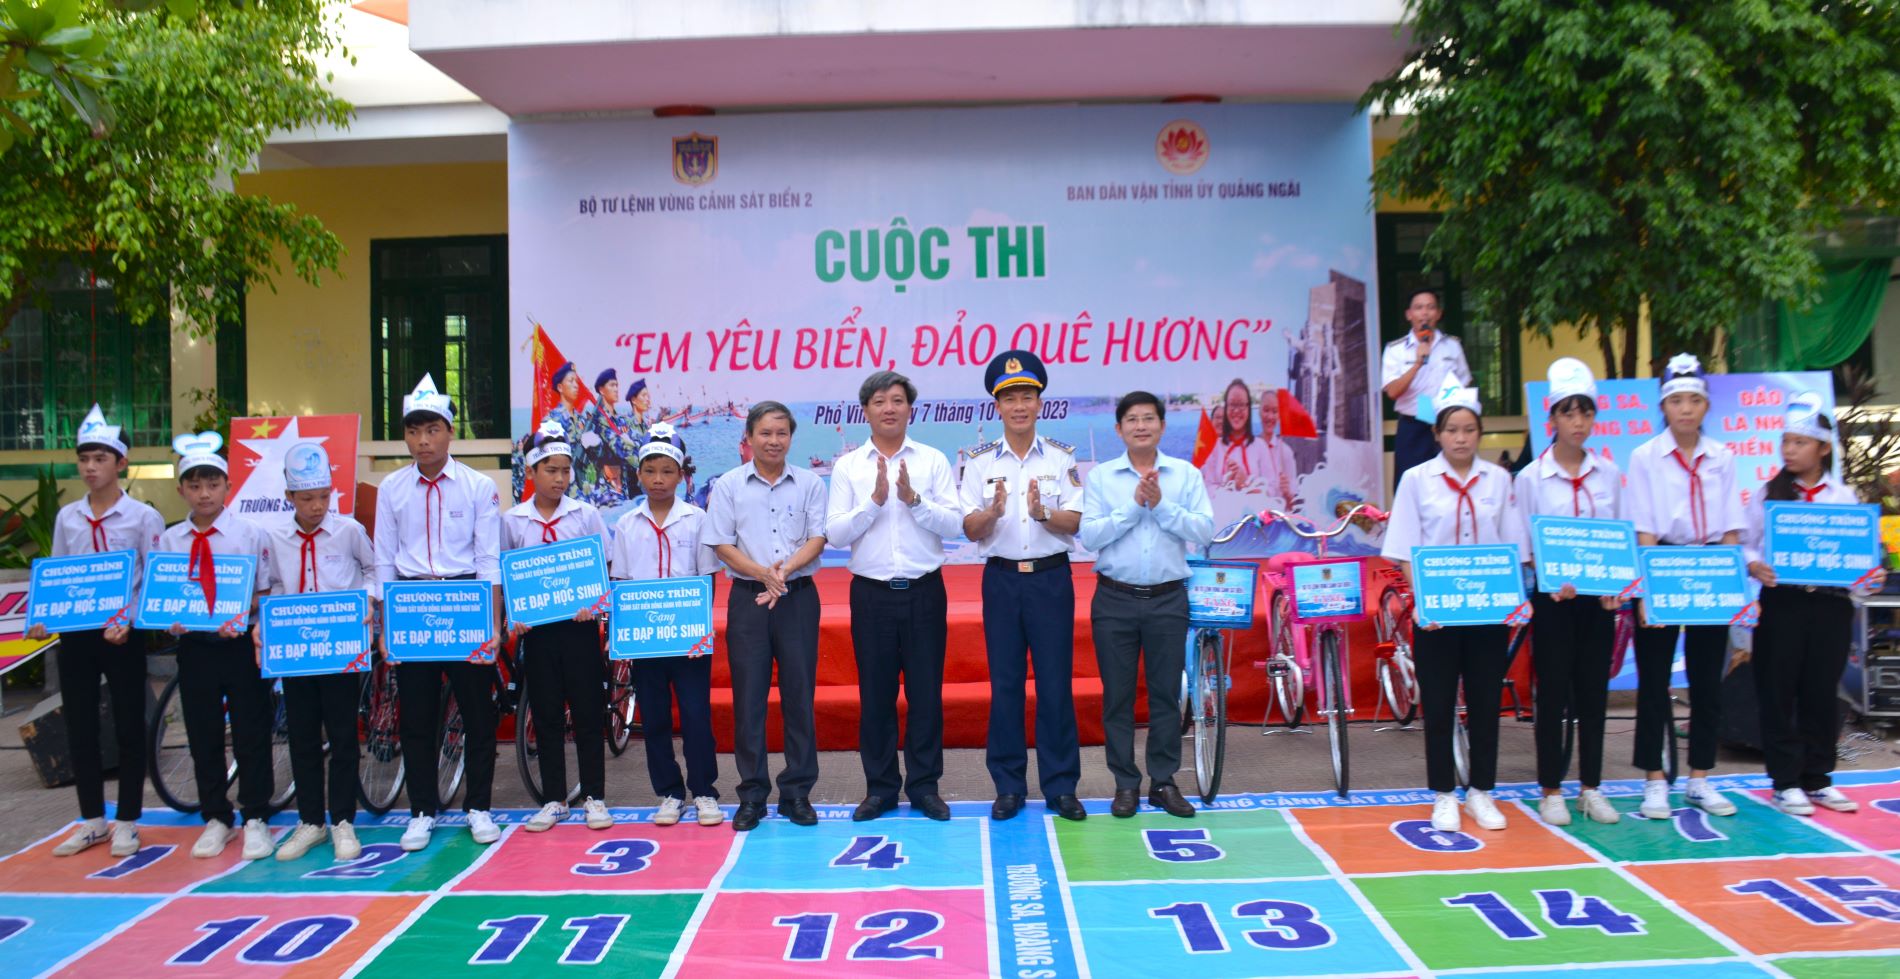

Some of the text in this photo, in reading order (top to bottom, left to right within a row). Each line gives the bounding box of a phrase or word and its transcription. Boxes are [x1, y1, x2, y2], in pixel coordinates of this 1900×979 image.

[579, 185, 813, 217] BỘ TƯ LỆNH VÙNG CẢNH SÁT BIỂN 2
[1066, 184, 1095, 201] BAN
[1099, 181, 1127, 201] DÂN
[1131, 181, 1159, 204] VẬN
[1163, 178, 1193, 200] TỈNH
[1218, 177, 1264, 200] QUẢNG
[815, 216, 1046, 293] CUỘC THI
[615, 306, 1272, 374] “EM YÊU BIỂN, ĐẢO QUÊ HƯƠNG”
[814, 400, 842, 425] Phổ
[922, 403, 931, 423] 7
[934, 401, 973, 424] tháng
[979, 403, 994, 422] 10
[1036, 400, 1068, 421] 023
[239, 495, 281, 513] TRƯỜNG
[42, 561, 123, 577] CHƯƠNG TRÌNH
[511, 547, 592, 571] CHƯƠNG TRÌNH
[33, 595, 124, 618] XE ĐẠP HỌC SINH
[145, 598, 161, 612] XE
[163, 599, 187, 615] ĐẠP
[215, 600, 242, 614] SINH
[395, 590, 480, 602] CHƯƠNG TRÌNH
[512, 582, 603, 612] XE ĐẠP HỌC SINH
[620, 586, 701, 600] CHƯƠNG TRÌNH
[1424, 592, 1520, 611] XE ĐẠP HỌC SINH
[271, 601, 356, 616] CHƯƠNG TRÌNH
[423, 613, 454, 630] Tặng
[645, 610, 675, 625] Tặng
[393, 628, 485, 647] XE ĐẠP HỌC SINH
[617, 623, 706, 643] XE ĐẠP HỌC SINH
[268, 640, 361, 661] XE ĐẠP HỌC SINH
[570, 839, 660, 876] 3
[829, 835, 910, 870] 4
[1141, 828, 1227, 863] 5
[86, 844, 178, 880] 1
[301, 843, 408, 879] 2
[1006, 864, 1048, 900] TRƯỜNG
[1008, 903, 1045, 921] SA,
[1440, 889, 1648, 939] 14
[1723, 875, 1900, 926] 15
[164, 914, 360, 966] 10
[467, 914, 631, 965] 11
[772, 908, 945, 961] 12
[1148, 899, 1337, 954] 13
[1012, 922, 1058, 966] HOÀNG
